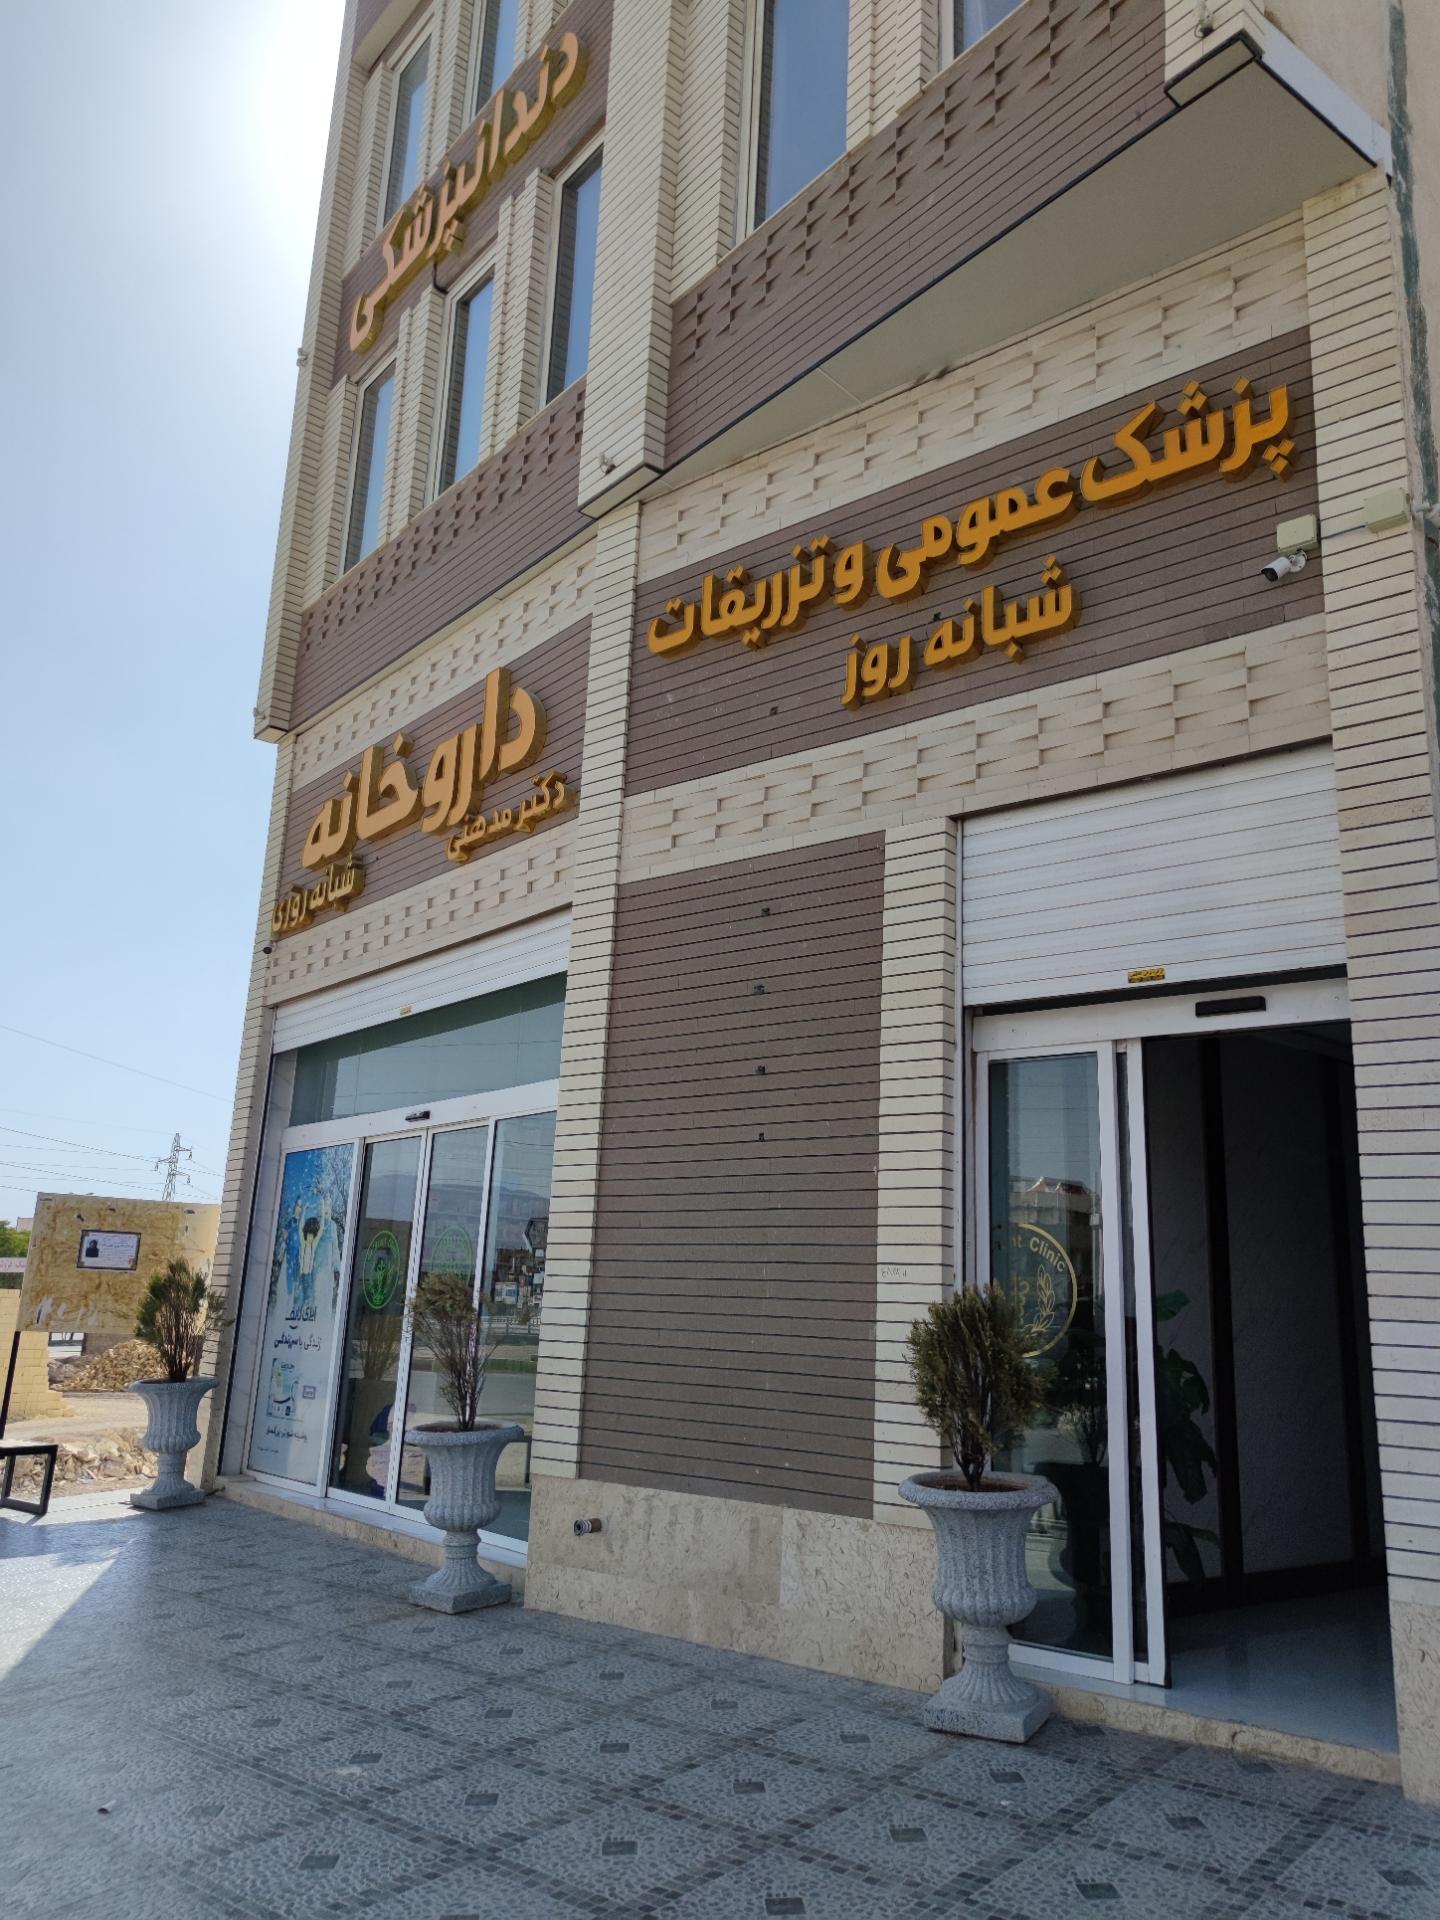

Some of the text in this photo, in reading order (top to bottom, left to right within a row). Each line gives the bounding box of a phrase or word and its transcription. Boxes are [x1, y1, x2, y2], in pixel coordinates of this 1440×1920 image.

[1080, 376, 1297, 501] پزشک
[876, 466, 1077, 601] عمومی
[841, 553, 1080, 710] شبانه روز
[302, 666, 546, 869] داروخانه
[514, 771, 574, 833] دکتر
[308, 853, 366, 912] شبانه
[1029, 1236, 1066, 1273] Clinic
